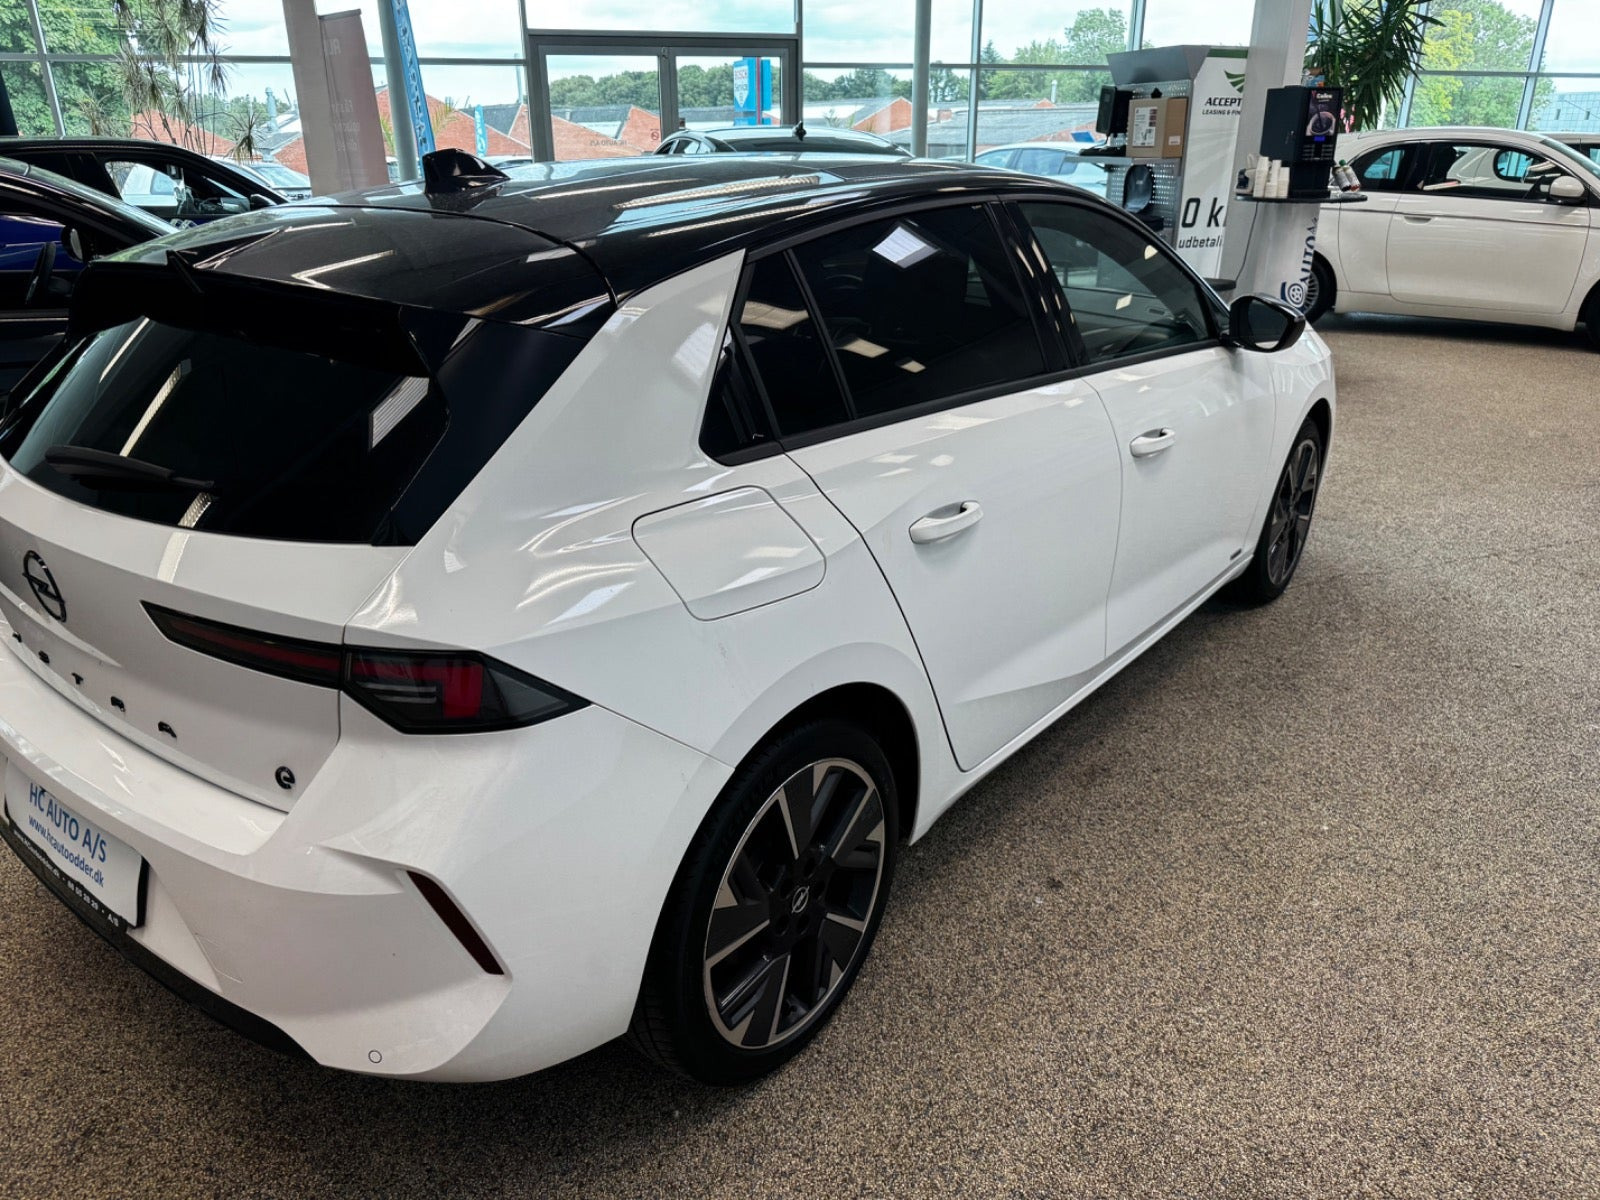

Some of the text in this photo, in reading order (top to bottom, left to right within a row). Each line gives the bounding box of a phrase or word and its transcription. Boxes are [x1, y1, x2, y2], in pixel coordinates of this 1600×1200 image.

[1204, 97, 1243, 107] ACCEPT
[28, 815, 105, 888] www.hcautoodder.dk
[29, 782, 46, 813] HC
[46, 799, 80, 841] AUTO
[82, 828, 108, 864] A/S
